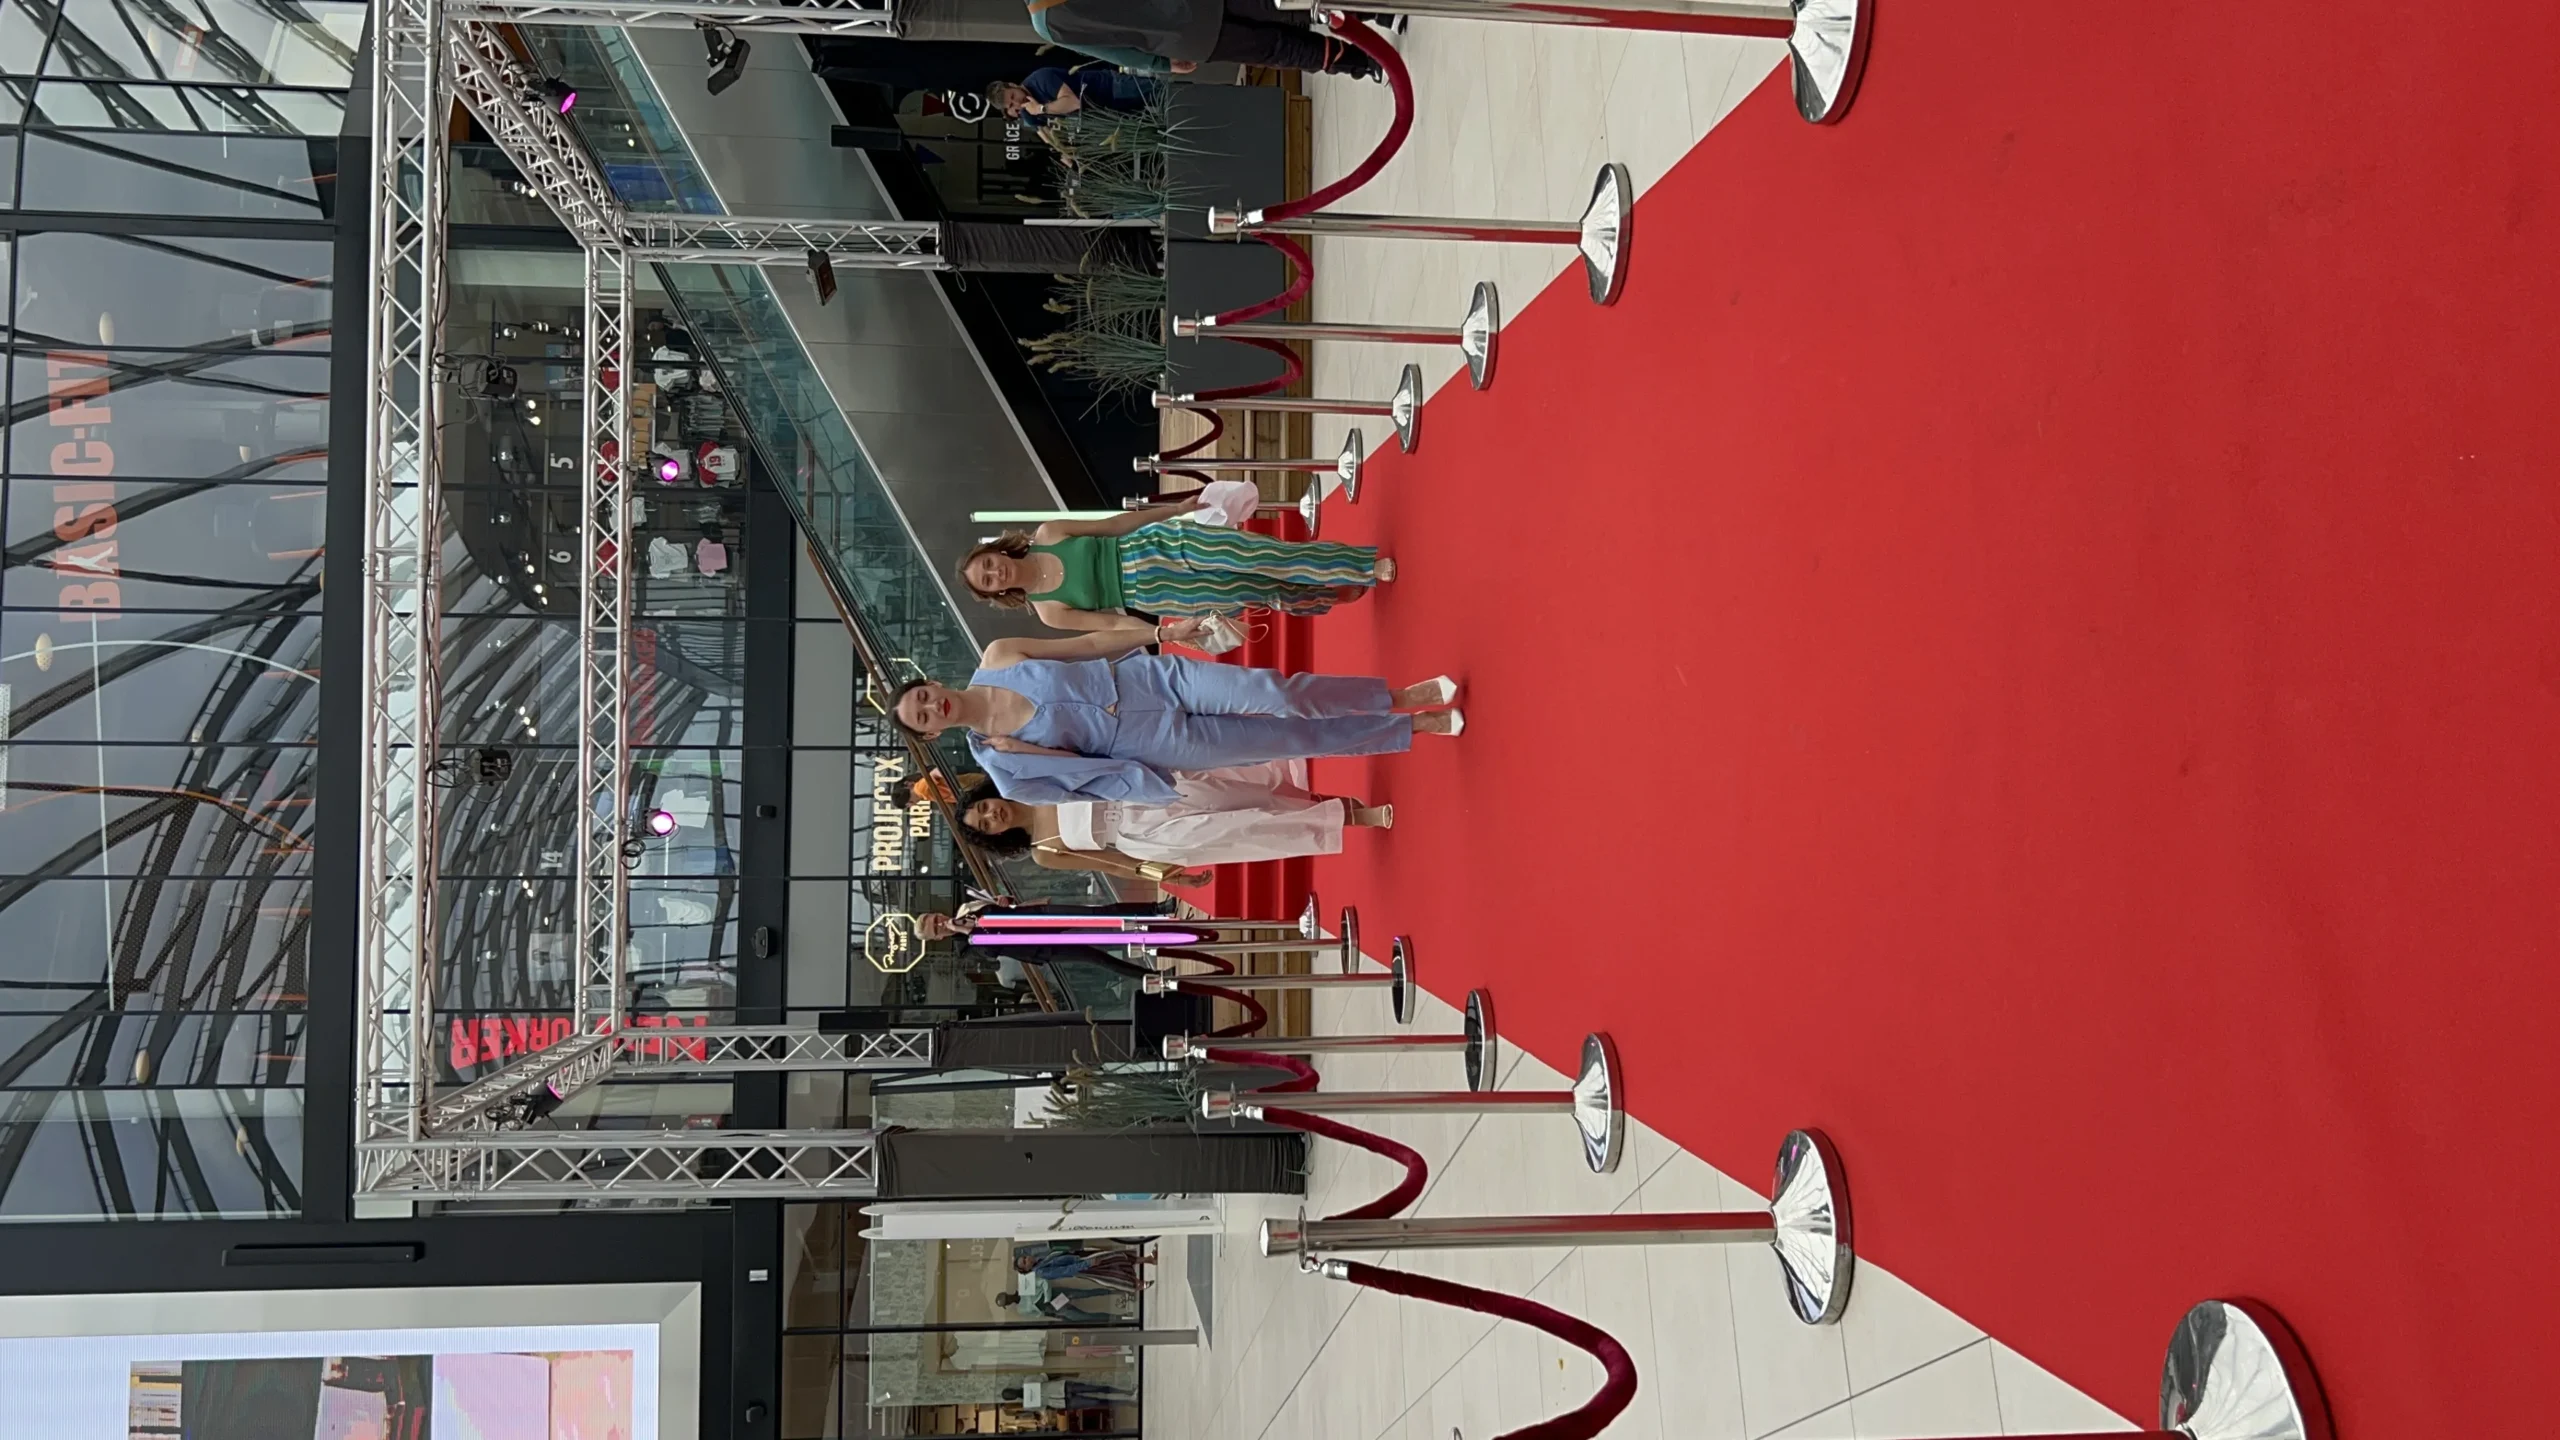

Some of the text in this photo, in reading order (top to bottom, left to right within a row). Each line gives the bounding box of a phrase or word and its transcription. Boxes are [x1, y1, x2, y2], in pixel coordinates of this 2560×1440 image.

[910, 800, 931, 837] PARI
[899, 930, 908, 952] PARIS
[450, 1017, 573, 1070] ORKER
